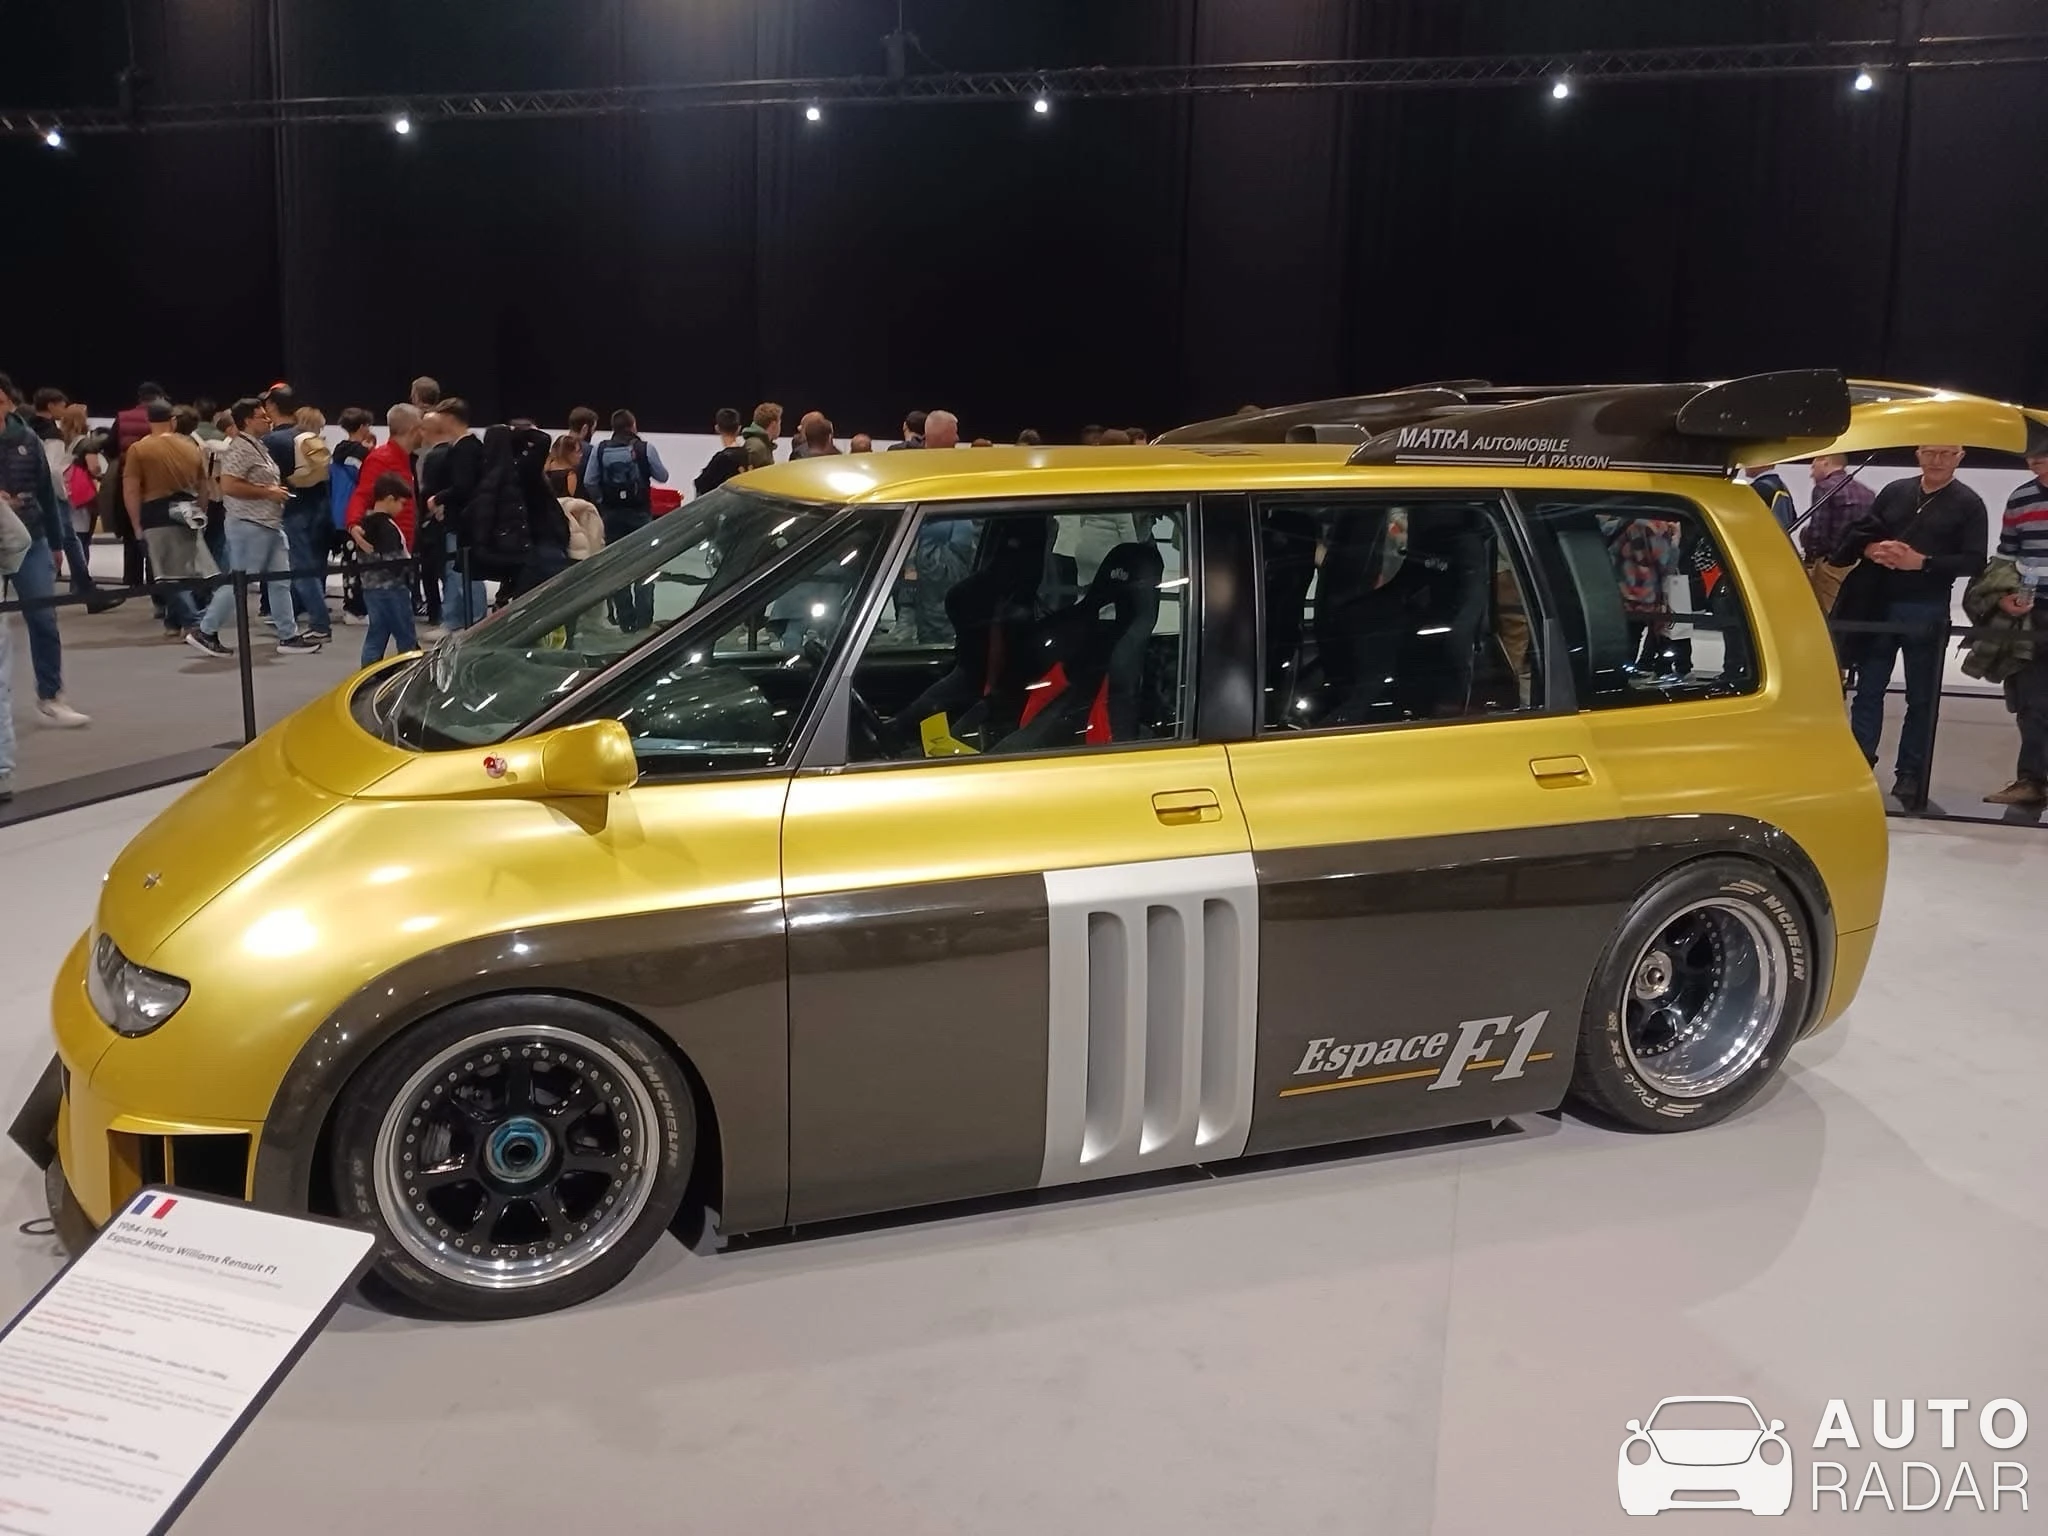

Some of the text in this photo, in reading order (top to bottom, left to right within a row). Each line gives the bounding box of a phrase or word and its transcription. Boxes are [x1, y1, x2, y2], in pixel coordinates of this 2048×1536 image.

[1396, 427, 1569, 453] MATRA AUTOMOBILE
[1526, 453, 1609, 470] LA PASSION
[1762, 894, 1805, 981] MICHELIN
[1293, 1009, 1551, 1092] Espace F1
[1610, 1039, 1627, 1069] SX
[641, 1064, 679, 1168] MICHELIN
[106, 1231, 142, 1249] Espace
[143, 1238, 174, 1255] Matra
[176, 1245, 220, 1265] Williams
[221, 1255, 264, 1273] Renault
[264, 1264, 278, 1276] F1
